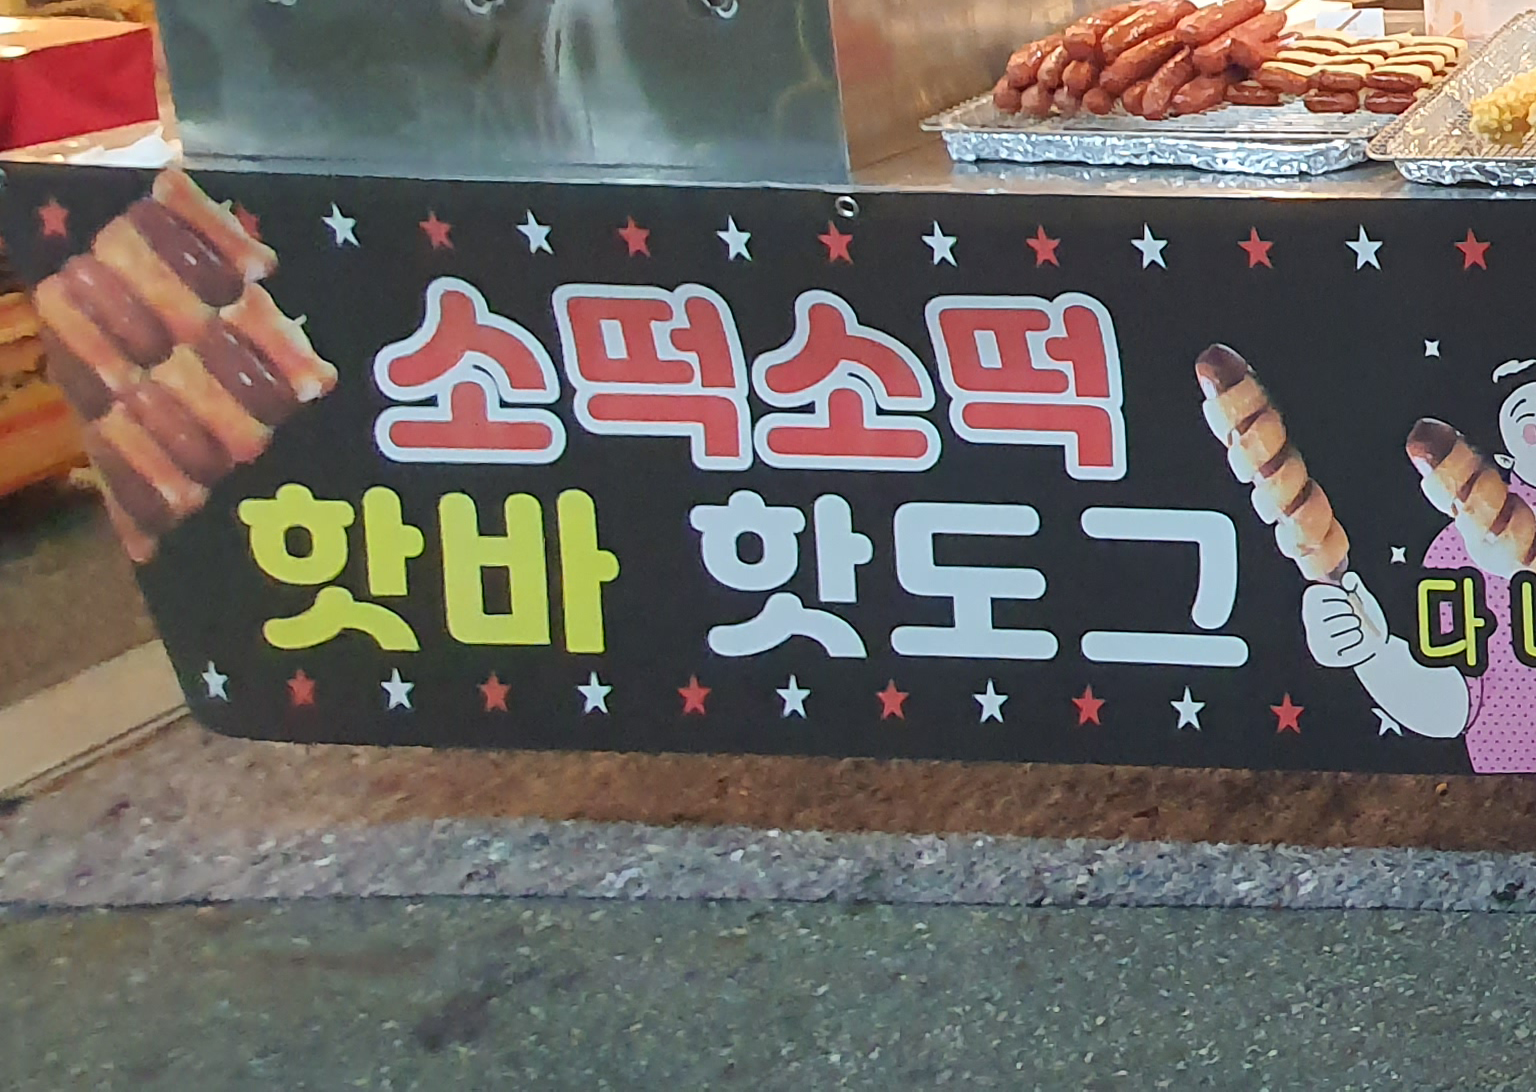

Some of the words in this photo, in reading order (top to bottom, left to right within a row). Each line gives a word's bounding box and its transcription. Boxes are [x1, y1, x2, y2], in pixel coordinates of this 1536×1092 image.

[375, 276, 1128, 481] 소떡소떡
[238, 483, 620, 653] 핫바
[689, 490, 1249, 667] 핫도그
[1418, 577, 1485, 666] 다
